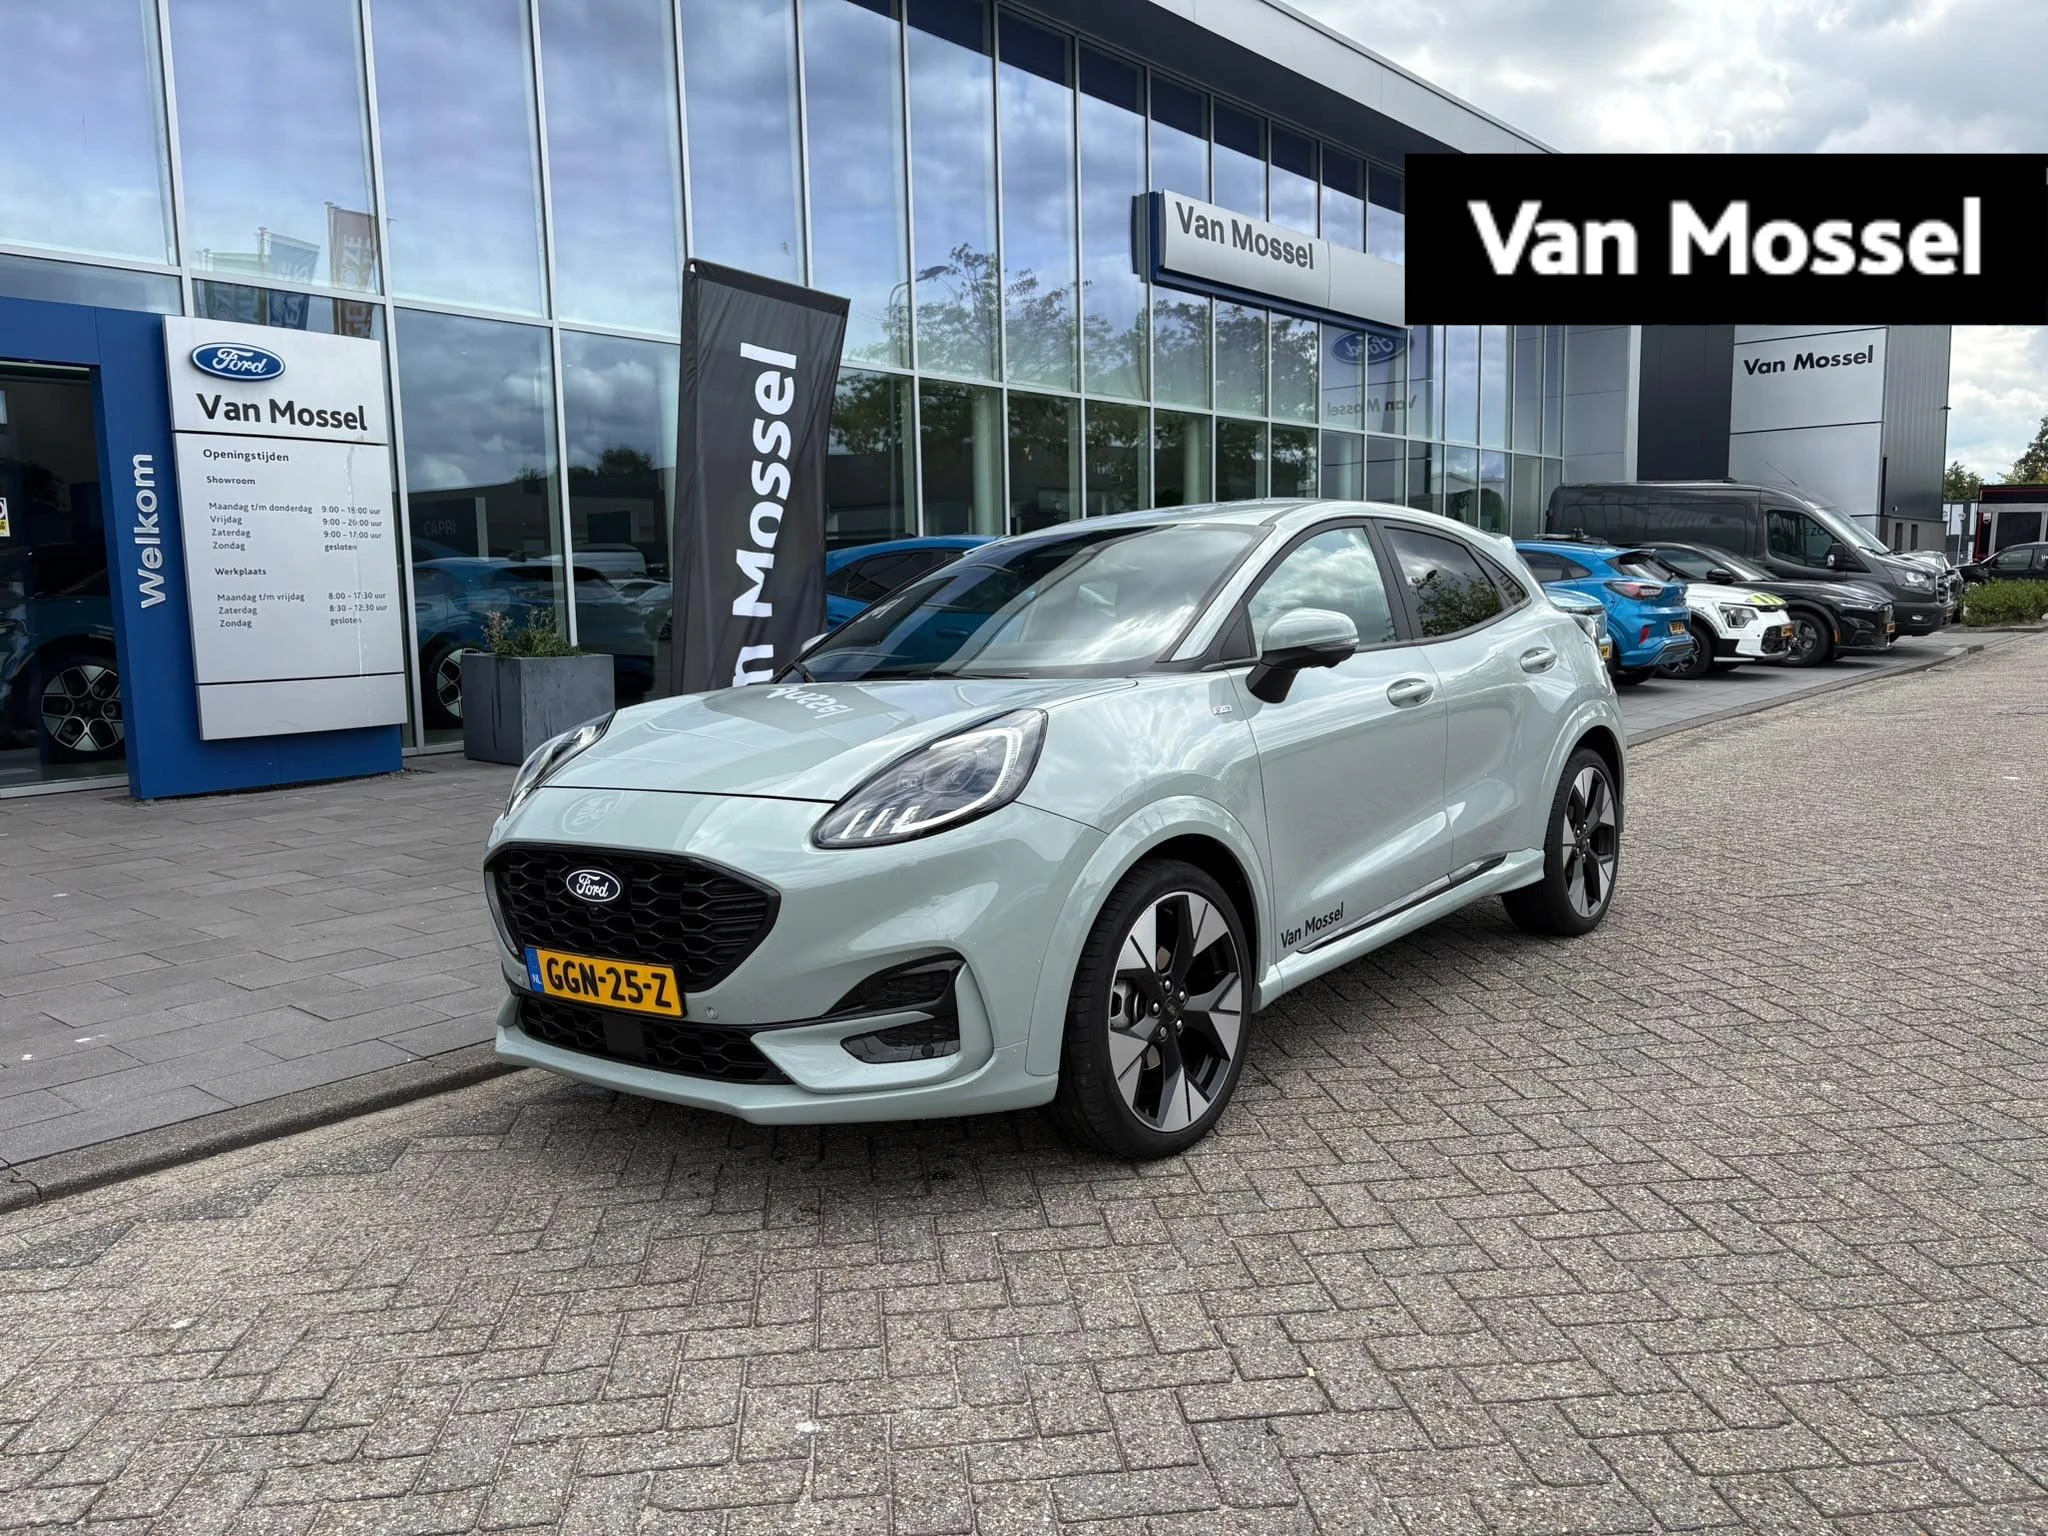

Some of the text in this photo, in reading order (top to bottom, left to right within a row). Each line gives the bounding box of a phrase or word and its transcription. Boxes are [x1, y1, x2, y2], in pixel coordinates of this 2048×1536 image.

[1175, 201, 1315, 270] Van Mossel
[212, 348, 267, 374] Ford
[1743, 345, 1874, 376] Van Mossel
[196, 393, 368, 431] Van Mossel
[203, 449, 290, 464] Openingstijden
[206, 476, 256, 485] Showroom
[732, 342, 798, 618] Mossel
[209, 502, 249, 513] Maandag
[269, 504, 313, 514] donderdag
[210, 515, 243, 526] Vrijdag
[423, 519, 457, 537] CAPRI
[132, 454, 166, 609] Welkom
[212, 528, 251, 539] Zaterdag
[213, 541, 357, 552] Zondag gesloten
[214, 567, 267, 577] Werkplaats
[217, 593, 257, 603] Maandag
[258, 593, 275, 601] t/m
[277, 592, 305, 602] vrijdag
[218, 606, 258, 616] Zaterdag
[219, 619, 252, 629] Zondag
[576, 873, 609, 897] Ford
[1281, 900, 1344, 948] Van Mossel
[531, 973, 542, 985] NL
[546, 957, 672, 1008] GGN-25-Z
